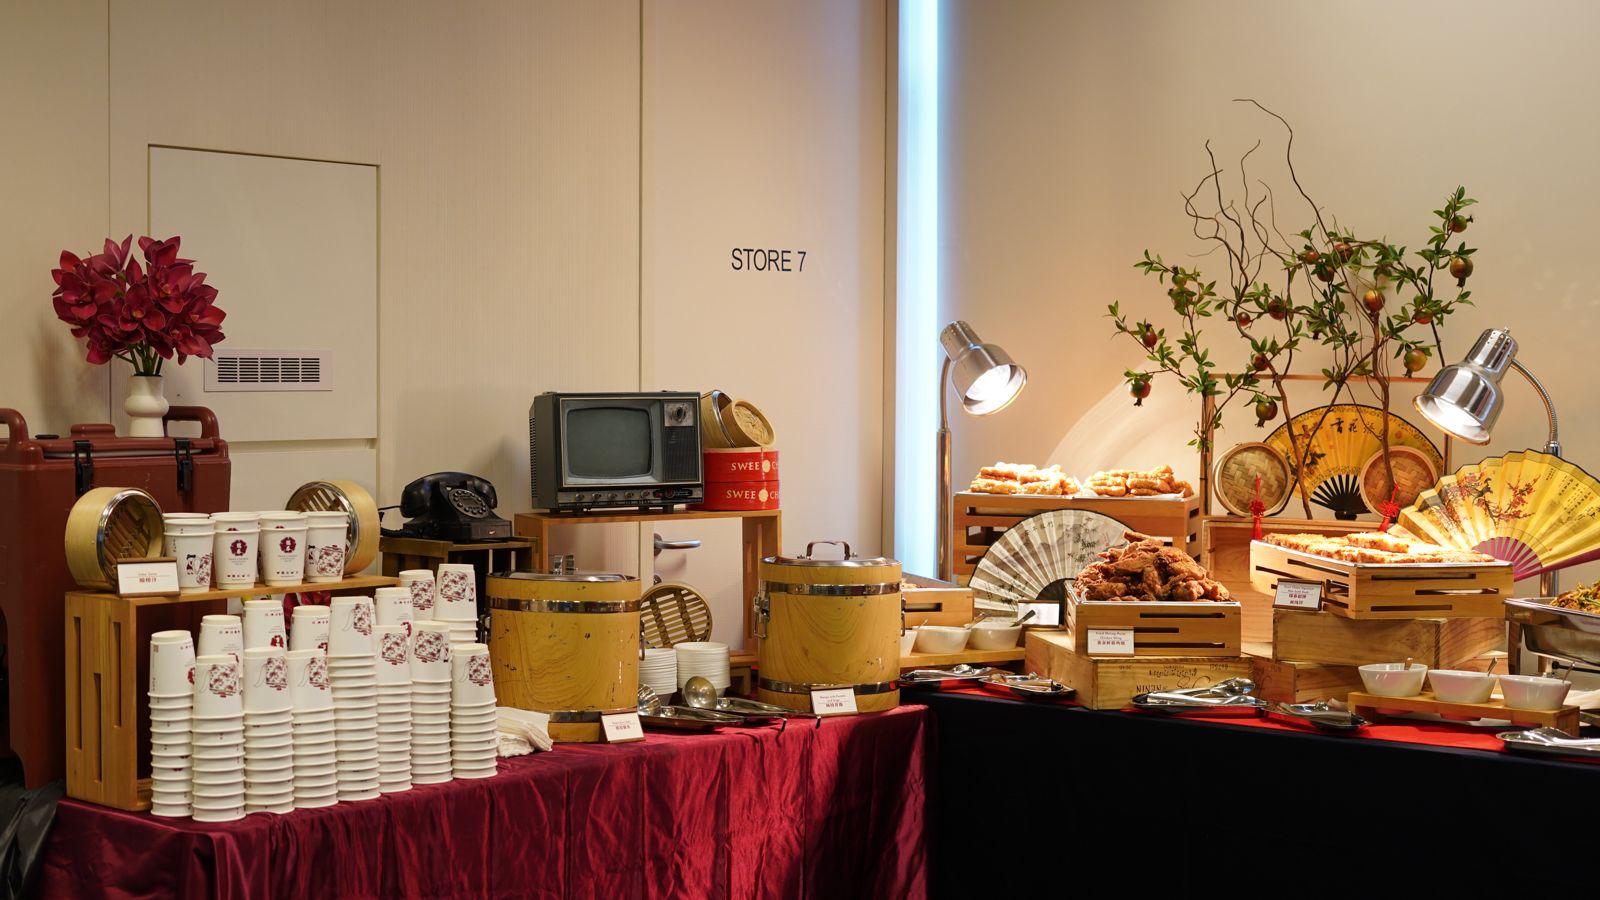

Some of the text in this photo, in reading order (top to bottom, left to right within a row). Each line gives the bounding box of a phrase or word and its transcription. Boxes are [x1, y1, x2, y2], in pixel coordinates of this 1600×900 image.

[731, 248, 807, 272] STORE 7
[731, 461, 760, 471] SWEE
[726, 489, 756, 500] SWEE
